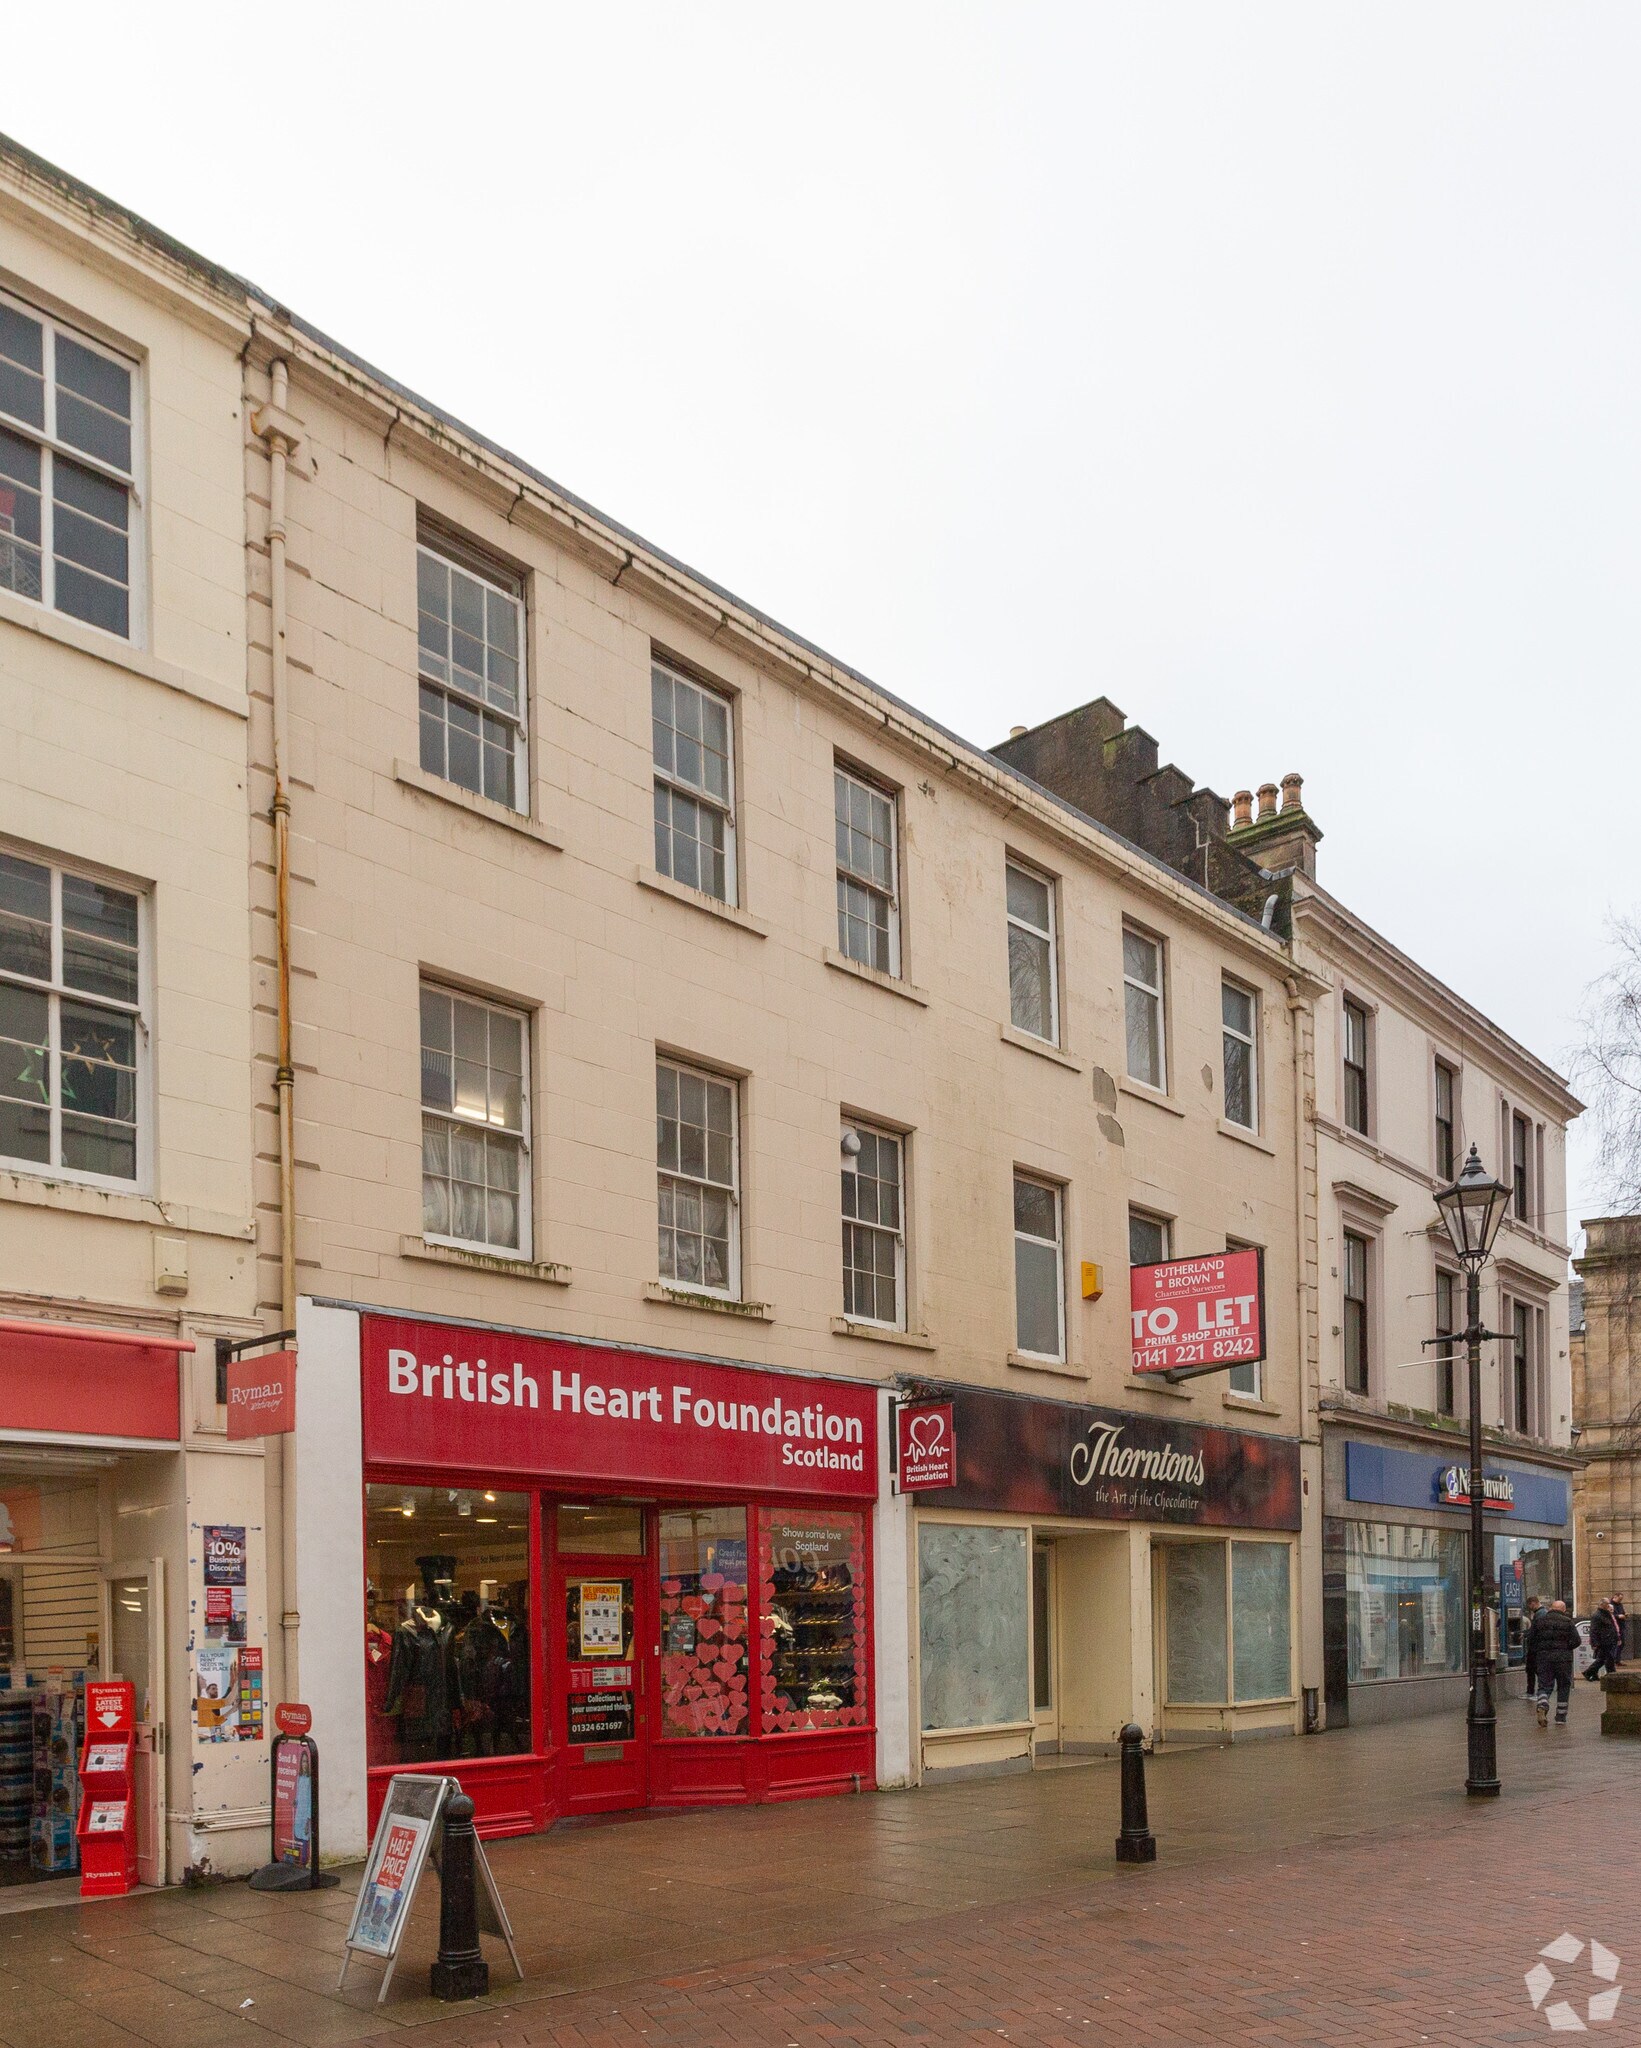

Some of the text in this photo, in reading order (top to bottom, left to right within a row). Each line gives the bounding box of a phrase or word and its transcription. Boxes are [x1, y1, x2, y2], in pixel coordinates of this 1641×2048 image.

[1154, 1260, 1224, 1279] SUTHERLAND
[1168, 1273, 1210, 1288] BROWN
[1155, 1284, 1225, 1299] Chartered Surveyors
[1131, 1295, 1255, 1339] TO LET
[1145, 1327, 1240, 1346] PRIME SHOP UNIT
[1133, 1338, 1254, 1368] 0141 221 8242
[231, 1382, 283, 1405] Ryman
[388, 1349, 863, 1444] British Heart Foundation
[782, 1443, 863, 1471] Scotland
[1070, 1421, 1205, 1486] Thorntons
[906, 1462, 948, 1473] British Heart
[906, 1472, 948, 1482] Foundation
[1096, 1485, 1199, 1515] the Art of the Chocolatier
[782, 1527, 841, 1540] Show some love
[208, 1541, 240, 1556] 10%
[795, 1540, 829, 1552] Scotland
[208, 1556, 241, 1564] Business
[208, 1564, 241, 1572] Discount
[587, 1694, 615, 1703] Collection
[281, 1710, 307, 1720] Ryman
[571, 1702, 632, 1714] your unwanted things
[572, 1721, 623, 1732] 01324 621697
[278, 1752, 297, 1764] Send &
[277, 1767, 297, 1776] receive
[277, 1779, 295, 1790] money
[277, 1789, 289, 1799] here
[389, 1837, 413, 1858] HALF
[382, 1855, 407, 1877] PRICE
